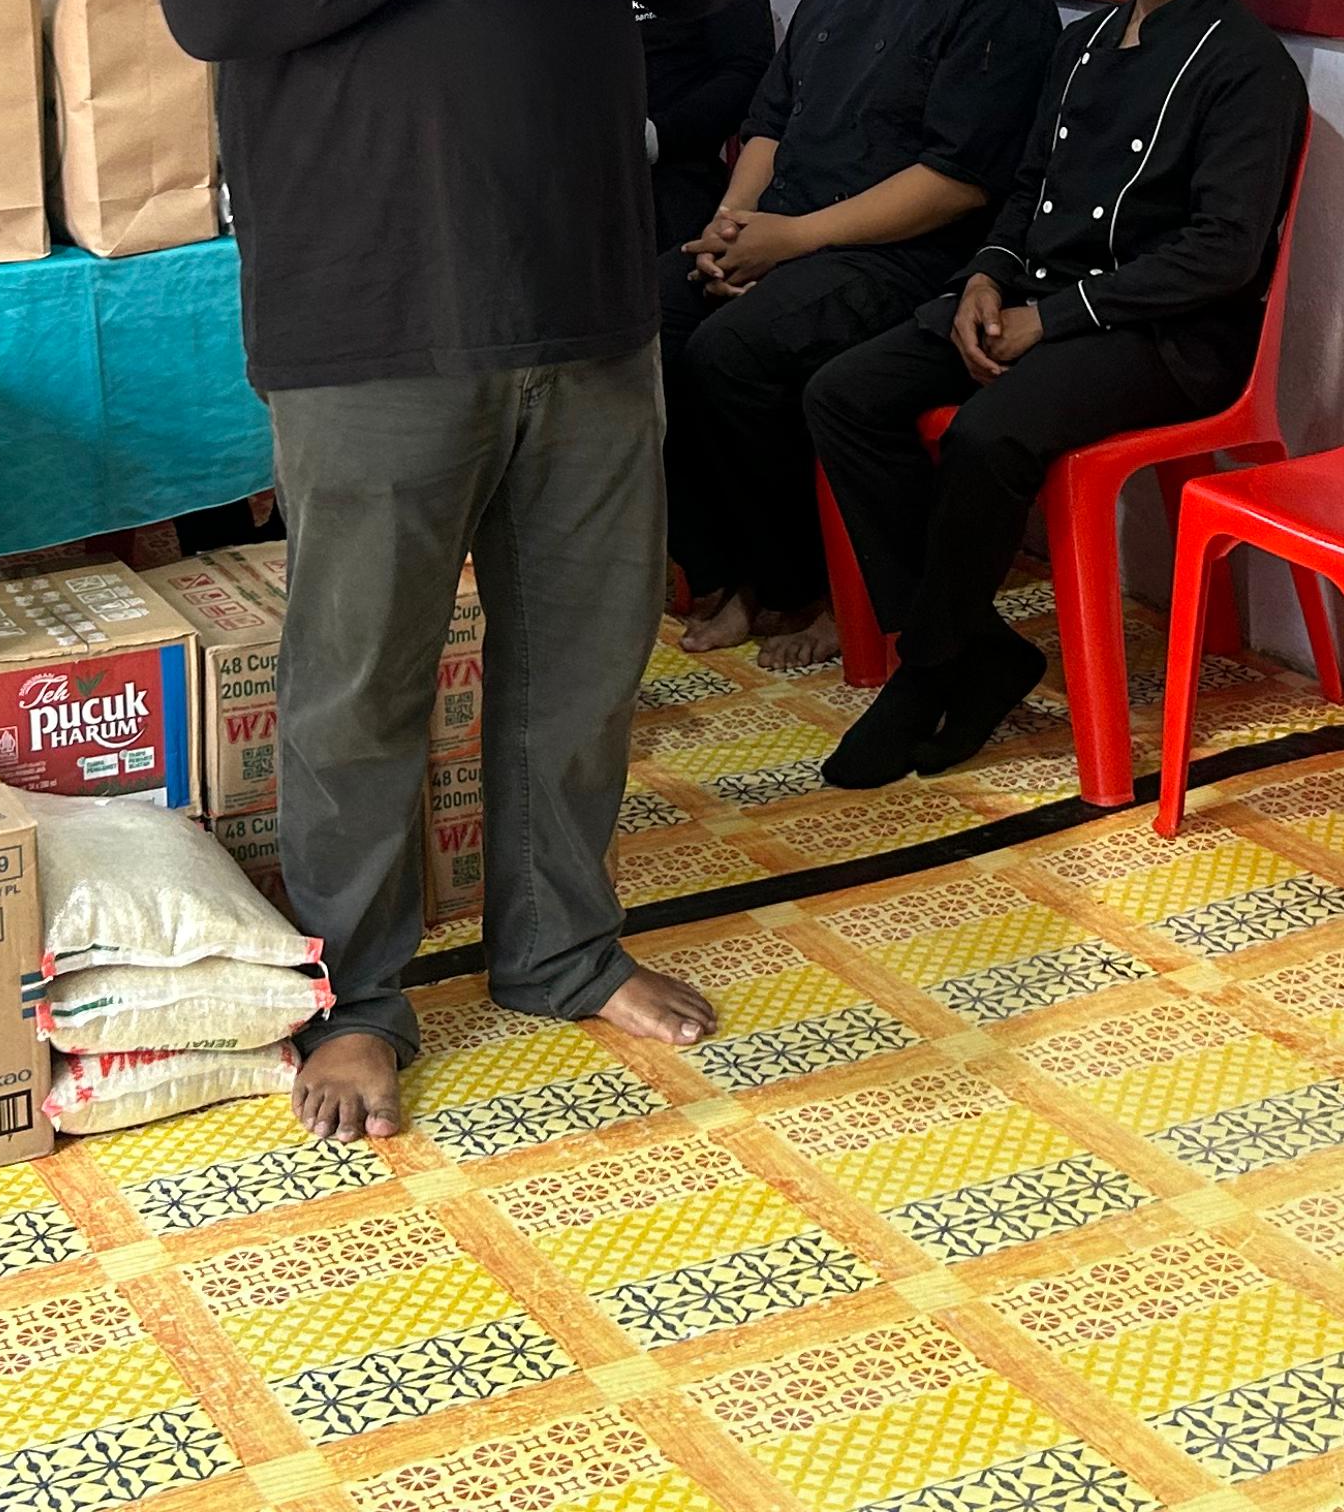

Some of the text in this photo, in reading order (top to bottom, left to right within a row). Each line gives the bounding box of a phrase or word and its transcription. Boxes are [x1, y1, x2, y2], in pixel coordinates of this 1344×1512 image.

[220, 657, 242, 676] 48
[19, 674, 70, 709] Teh
[221, 678, 277, 700] 200ml
[30, 682, 149, 751] pucuk
[51, 718, 138, 748] HARUM
[431, 770, 452, 788] 48
[225, 820, 247, 839] 48
[5, 884, 21, 897] PL
